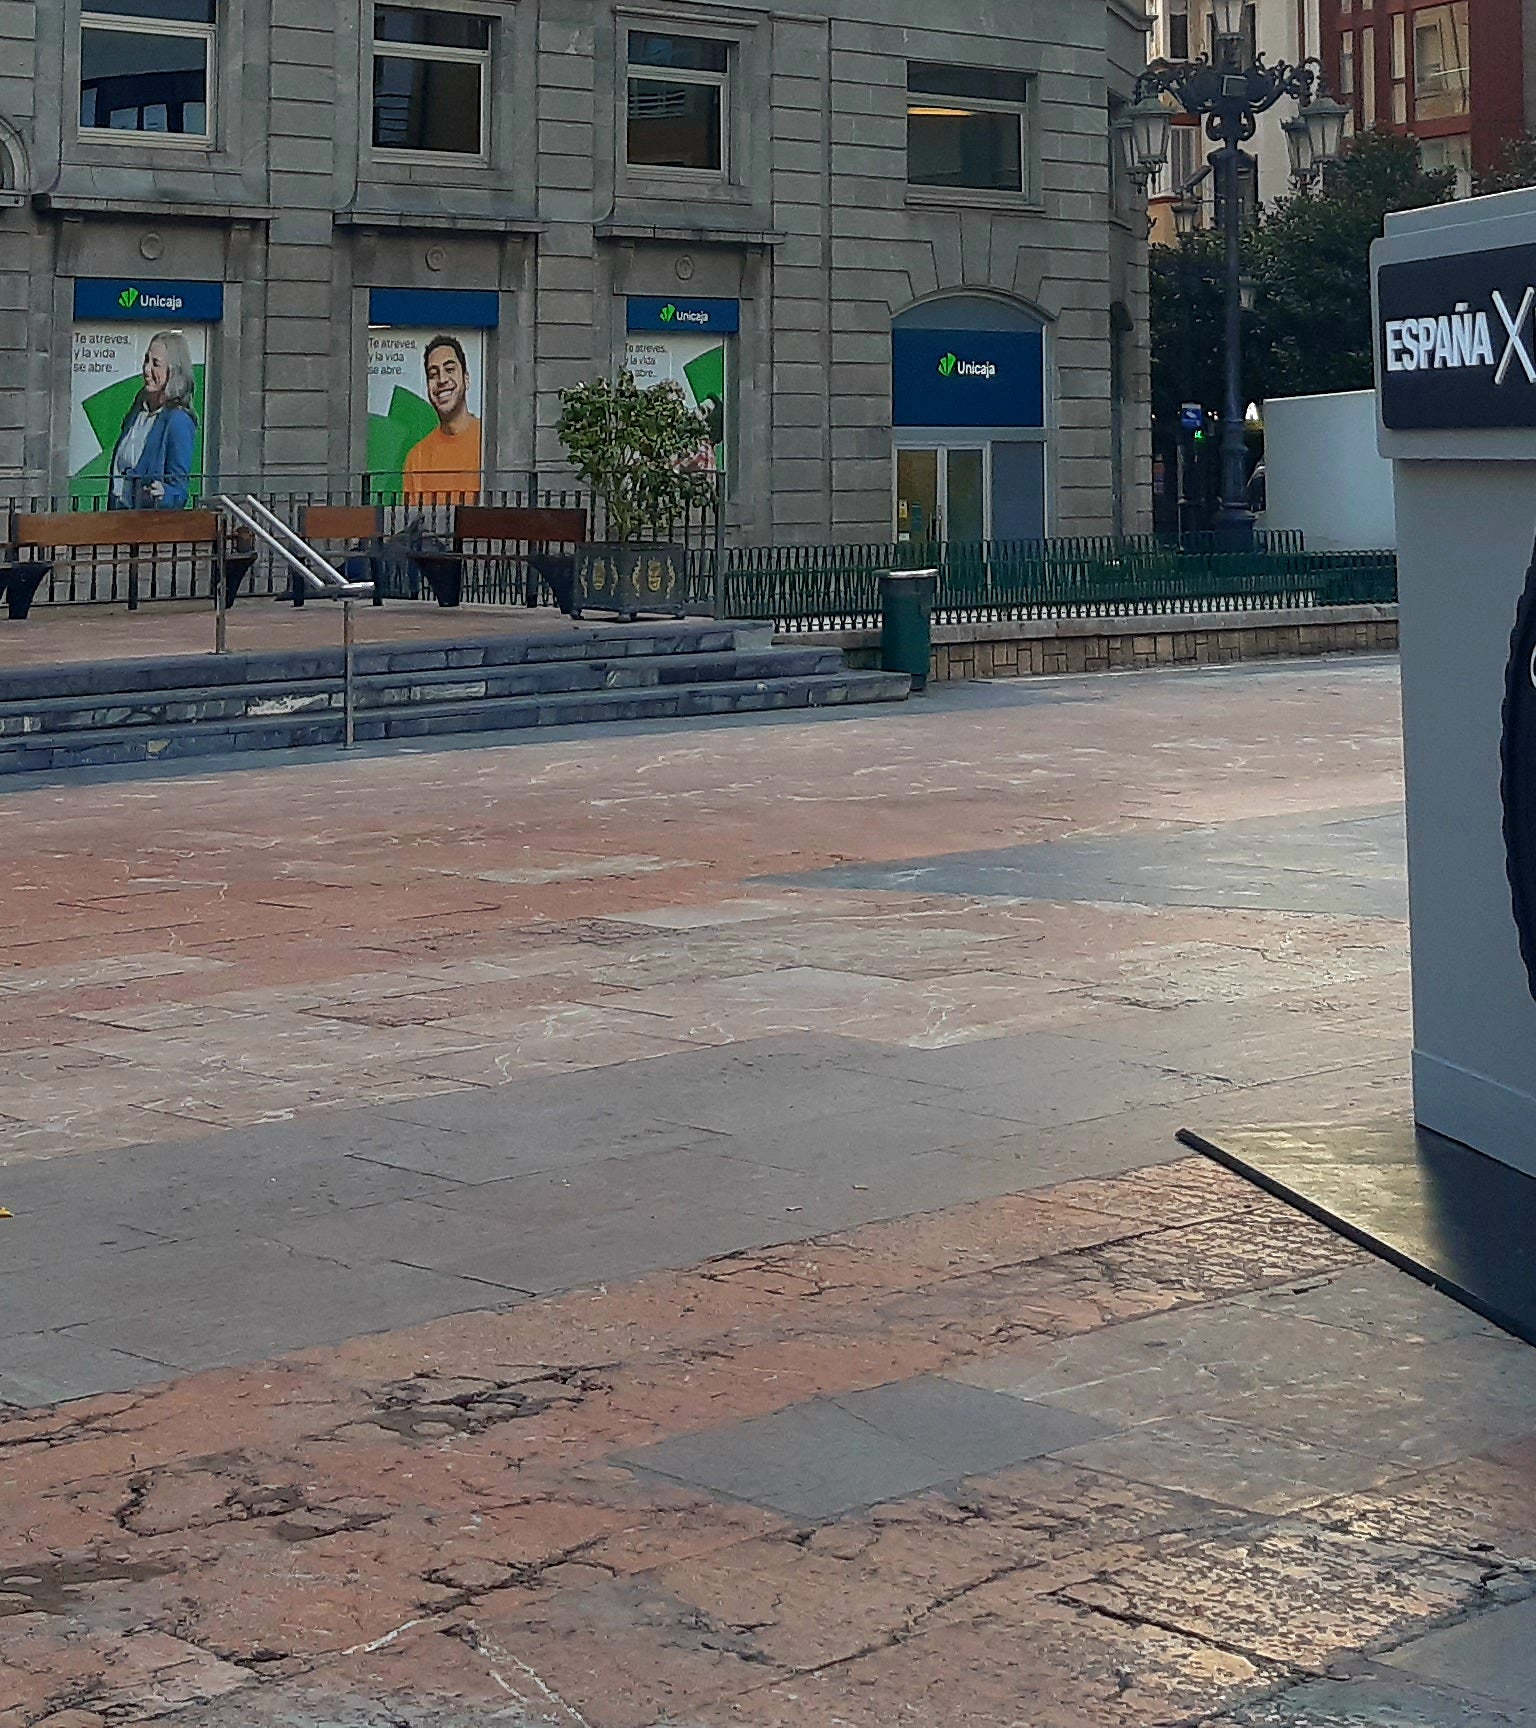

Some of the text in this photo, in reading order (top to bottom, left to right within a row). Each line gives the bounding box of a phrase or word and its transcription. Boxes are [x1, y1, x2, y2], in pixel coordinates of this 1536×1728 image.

[140, 294, 182, 311] Unicaja
[676, 310, 709, 324] Unicaja
[74, 332, 87, 344] Te
[1385, 302, 1495, 372] ESPAÑA
[73, 347, 116, 360] y la vida
[73, 363, 86, 372] se
[957, 361, 996, 379] Unicaja
